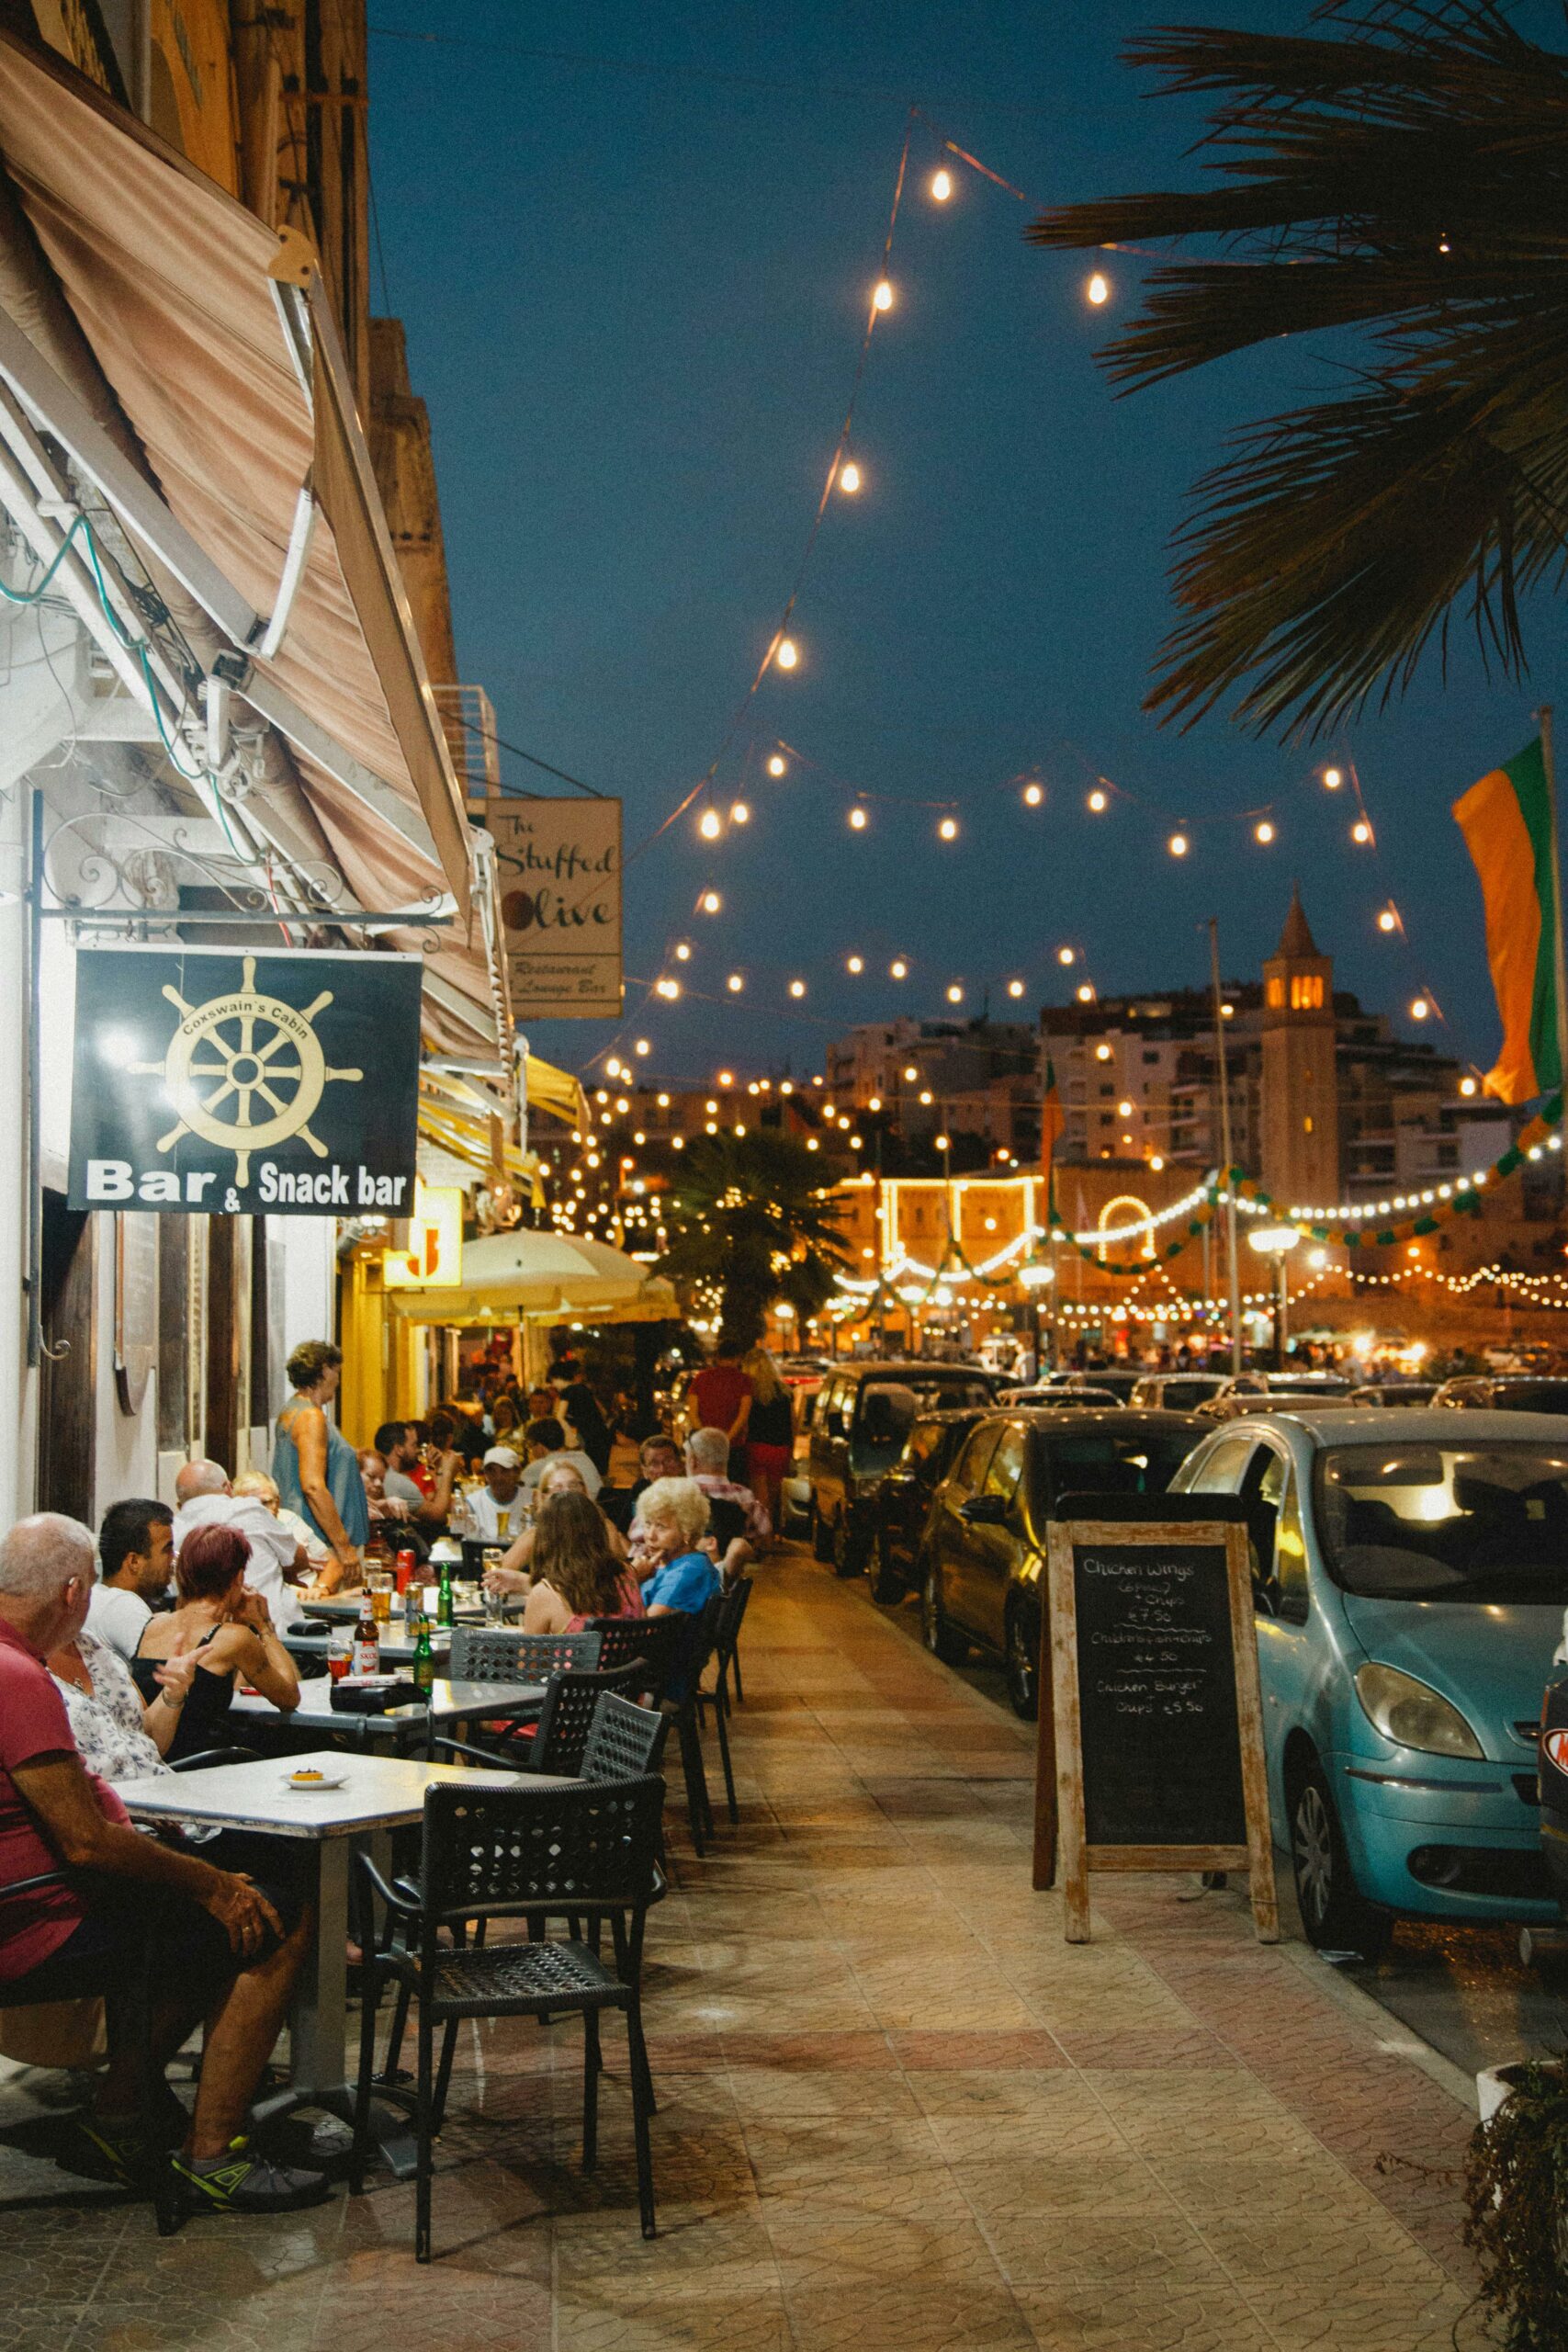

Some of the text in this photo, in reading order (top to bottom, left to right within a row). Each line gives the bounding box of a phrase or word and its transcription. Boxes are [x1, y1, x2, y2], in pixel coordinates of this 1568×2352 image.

[497, 814, 534, 839] The
[496, 842, 614, 879] Stuffed
[271, 1006, 309, 1040] Cabin
[85, 1159, 408, 1213] Bar & Snack bar
[1083, 1558, 1195, 1581] Chicken Wings
